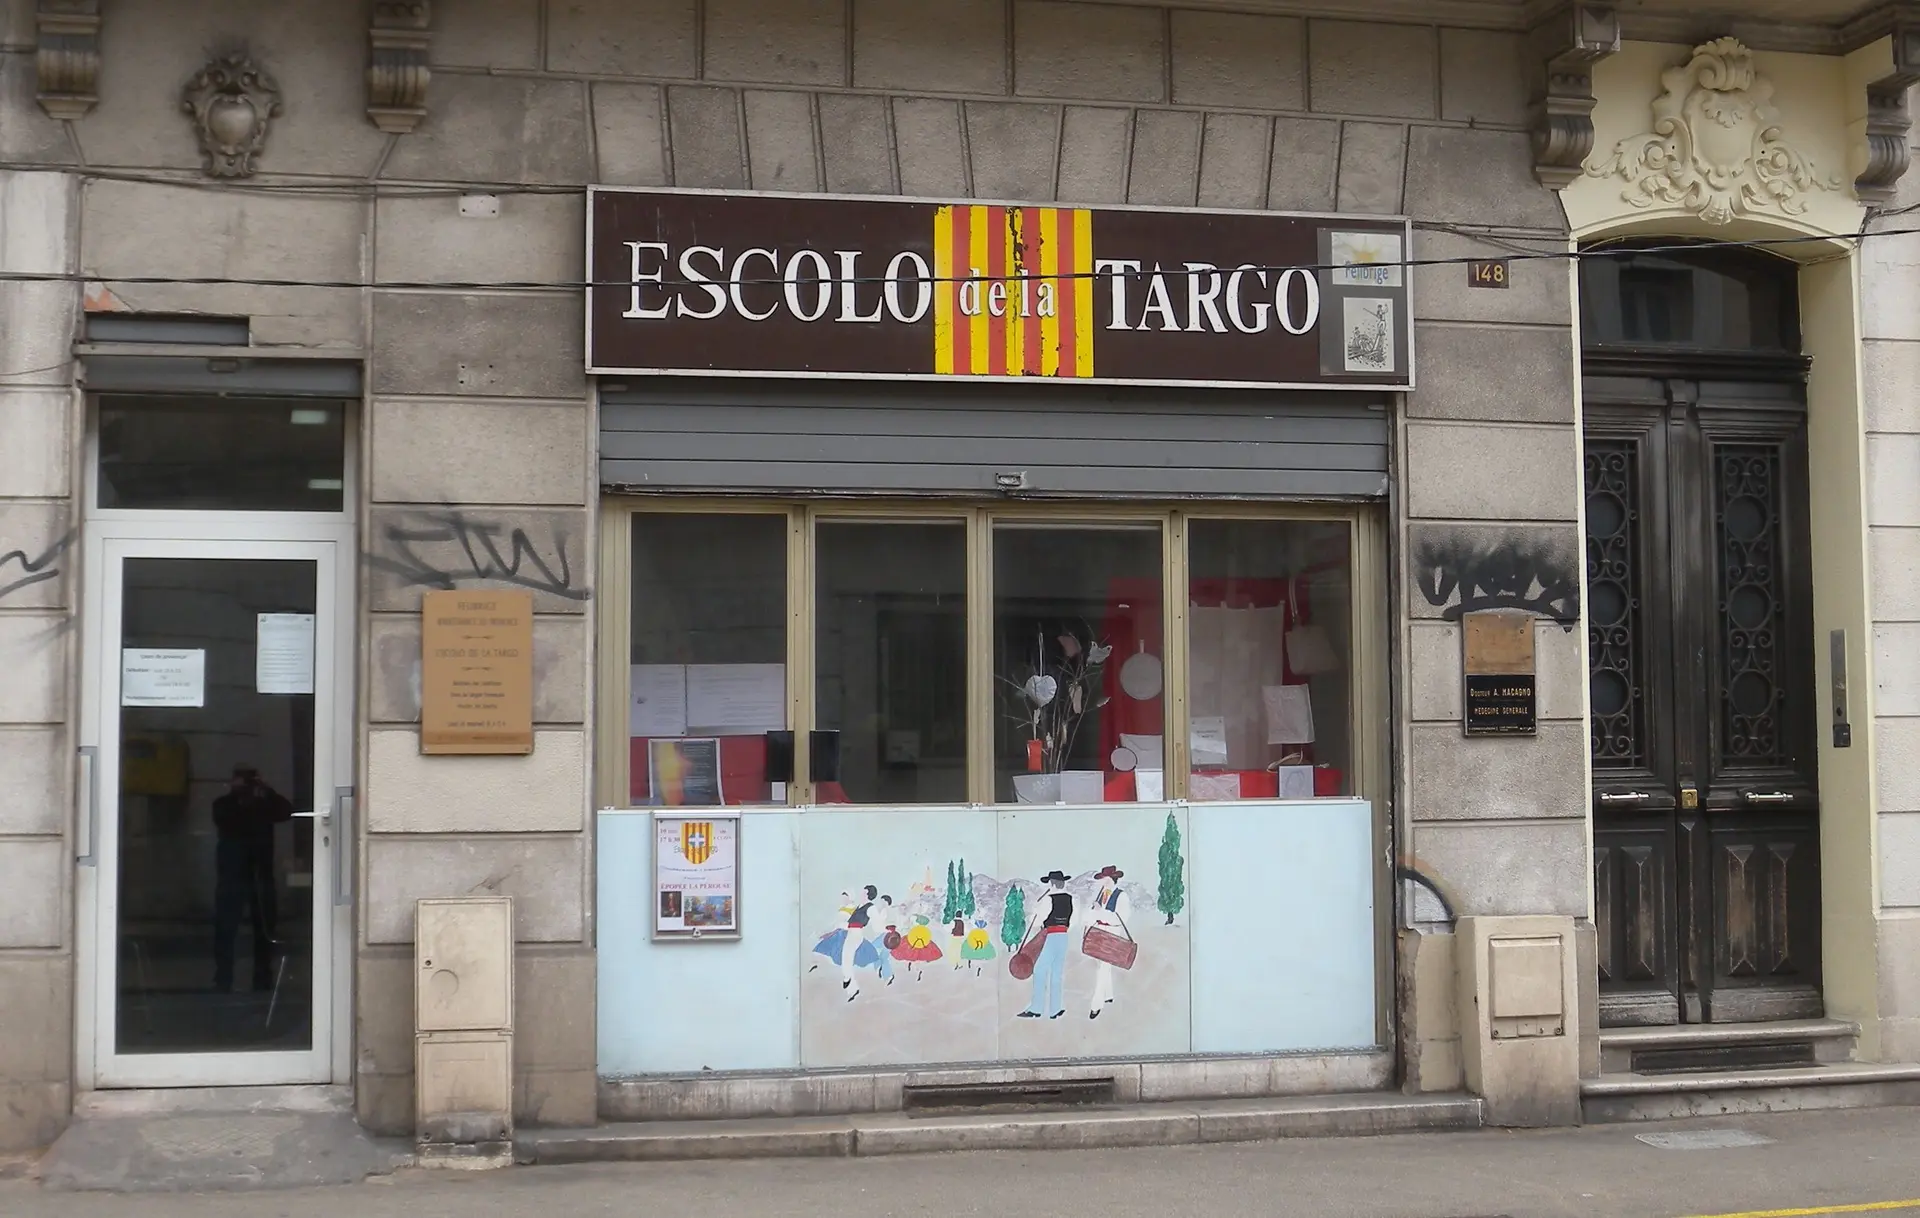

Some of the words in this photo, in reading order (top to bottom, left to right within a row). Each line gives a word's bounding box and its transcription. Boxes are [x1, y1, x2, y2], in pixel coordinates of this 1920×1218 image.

[1474, 263, 1505, 283] 148
[622, 240, 932, 324] ESCOLO
[958, 267, 1007, 318] de
[1018, 268, 1057, 318] la
[1095, 259, 1321, 335] TARGO
[1502, 687, 1532, 697] MACAGNO
